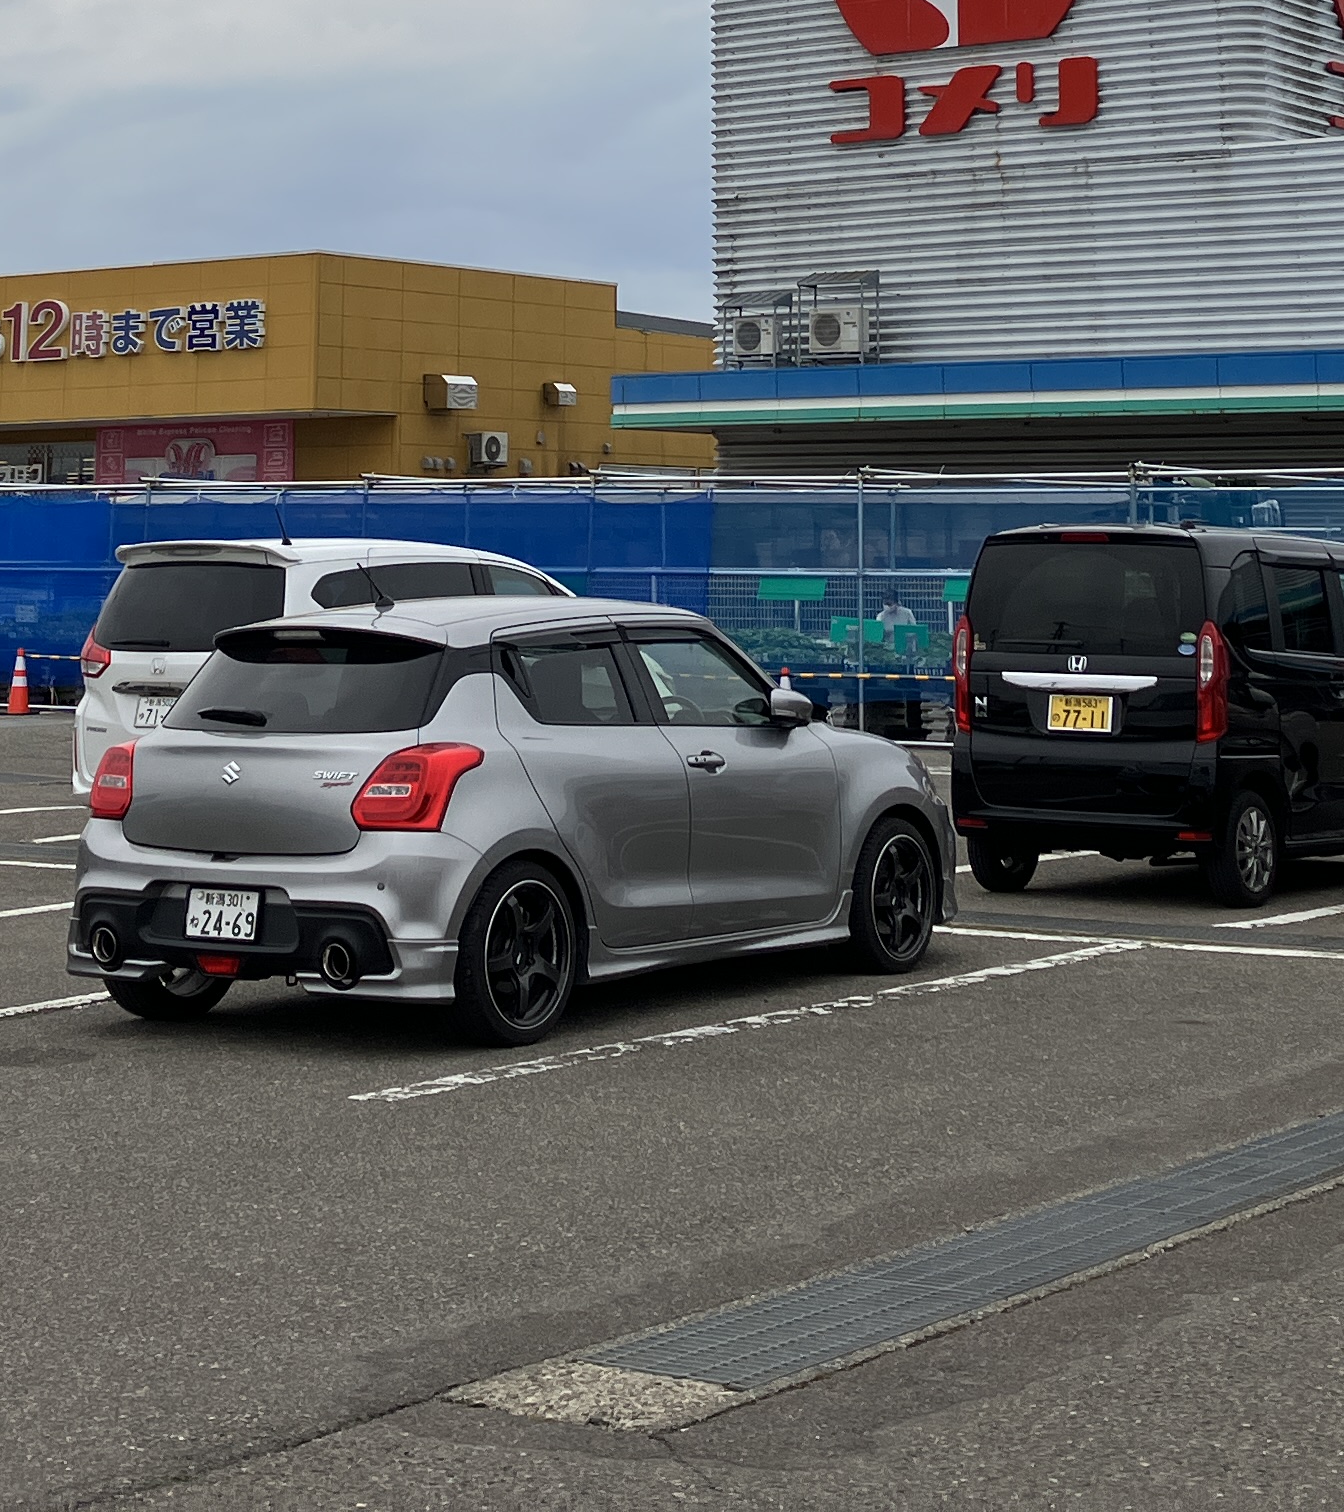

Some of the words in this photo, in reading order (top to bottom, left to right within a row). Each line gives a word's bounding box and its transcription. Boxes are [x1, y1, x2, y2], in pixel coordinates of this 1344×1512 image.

[829, 55, 1099, 145] コメリ
[1062, 709, 1105, 729] 77-11
[312, 770, 359, 780] SWIFT
[200, 908, 255, 939] 24-69
